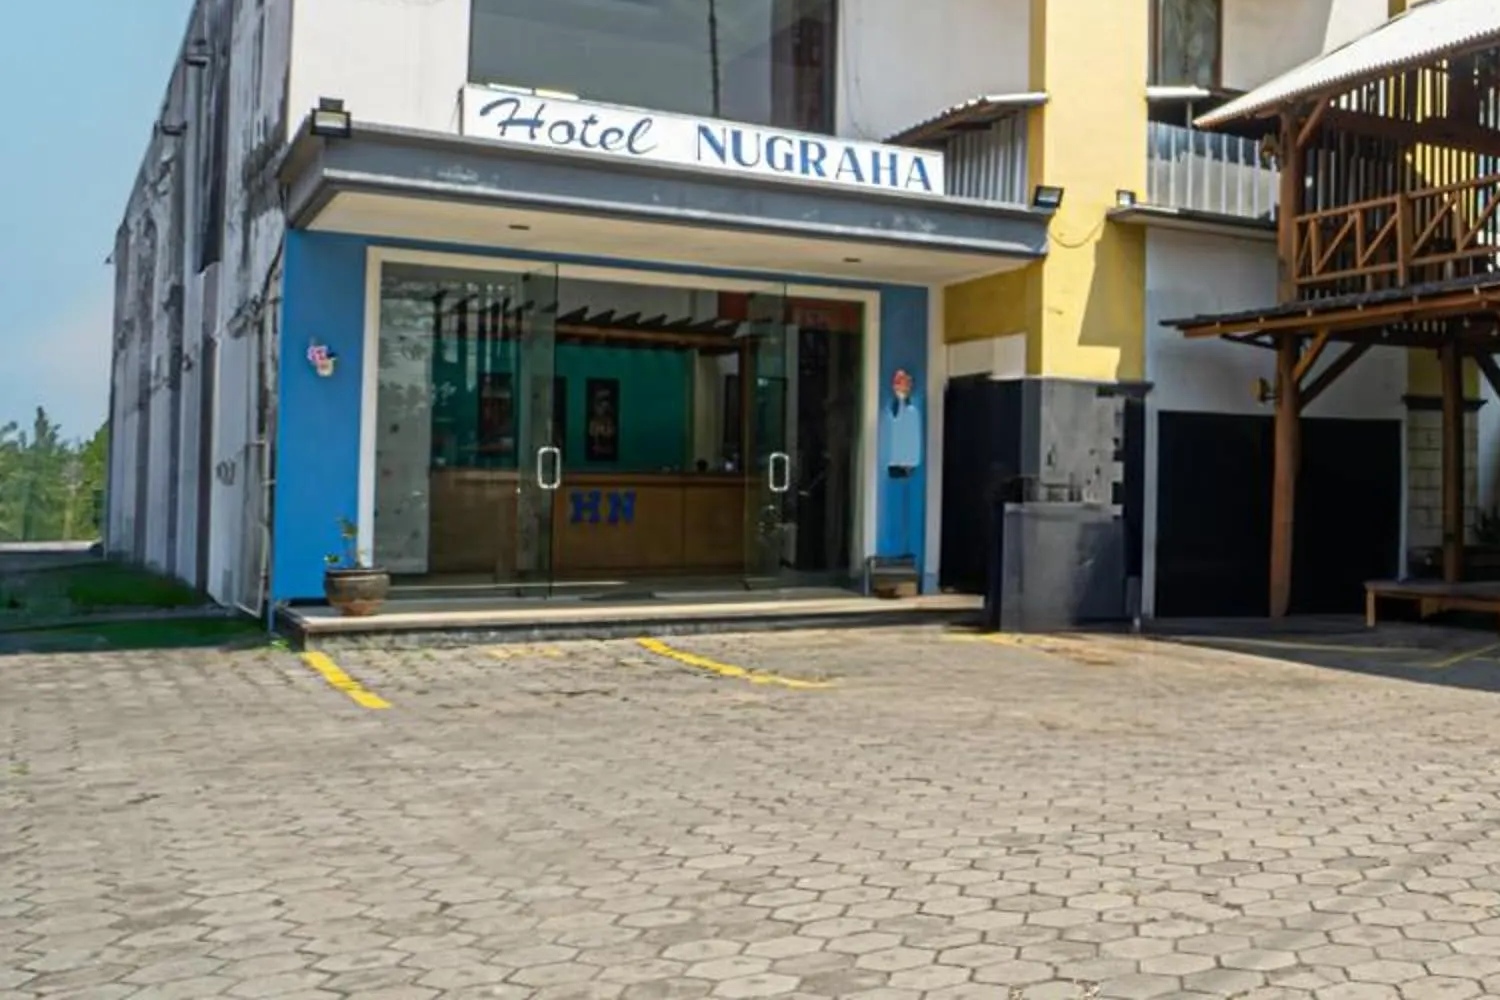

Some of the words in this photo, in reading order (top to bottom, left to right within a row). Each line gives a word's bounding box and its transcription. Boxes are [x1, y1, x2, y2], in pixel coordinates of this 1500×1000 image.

[480, 97, 656, 155] Hotel
[698, 125, 932, 191] NUGRAHA
[571, 489, 636, 524] HN
